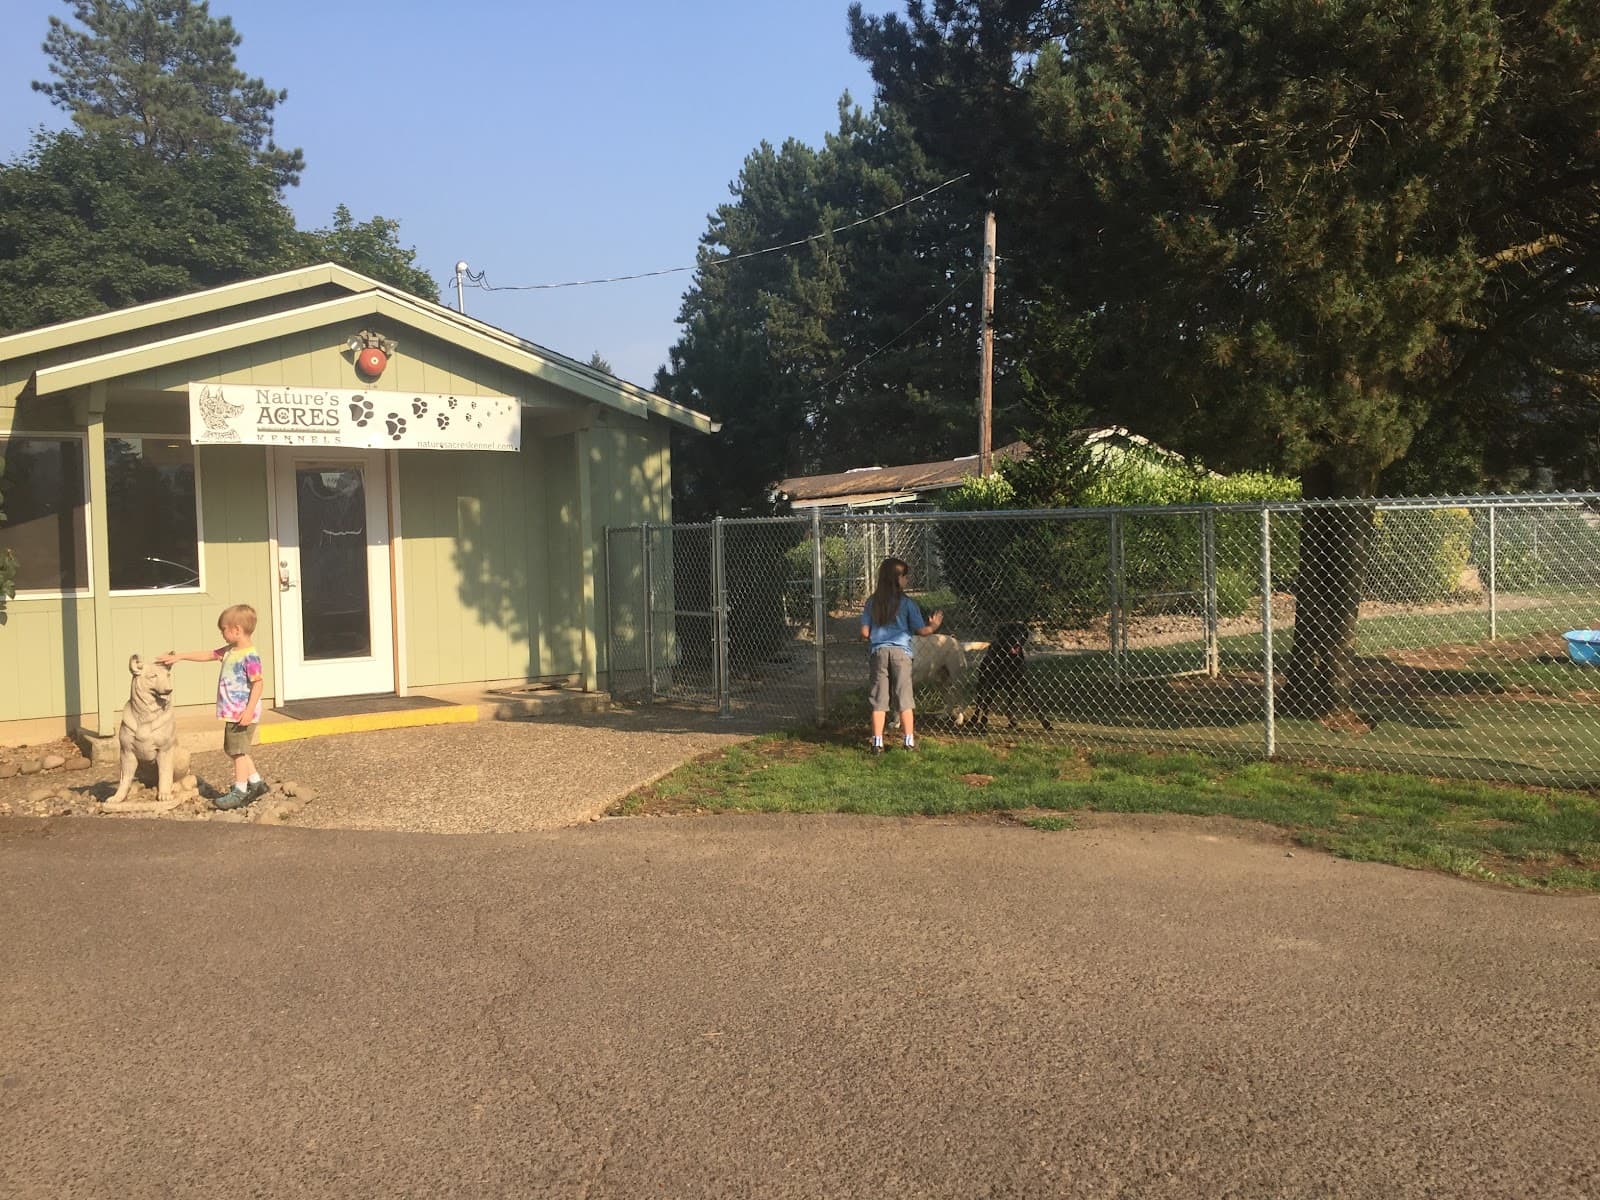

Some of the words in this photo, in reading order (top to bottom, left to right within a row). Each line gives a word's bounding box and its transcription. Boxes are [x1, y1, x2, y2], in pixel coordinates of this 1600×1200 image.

[256, 389, 340, 406] Nature's
[256, 407, 340, 426] ACRES
[257, 434, 341, 444] KENNELS
